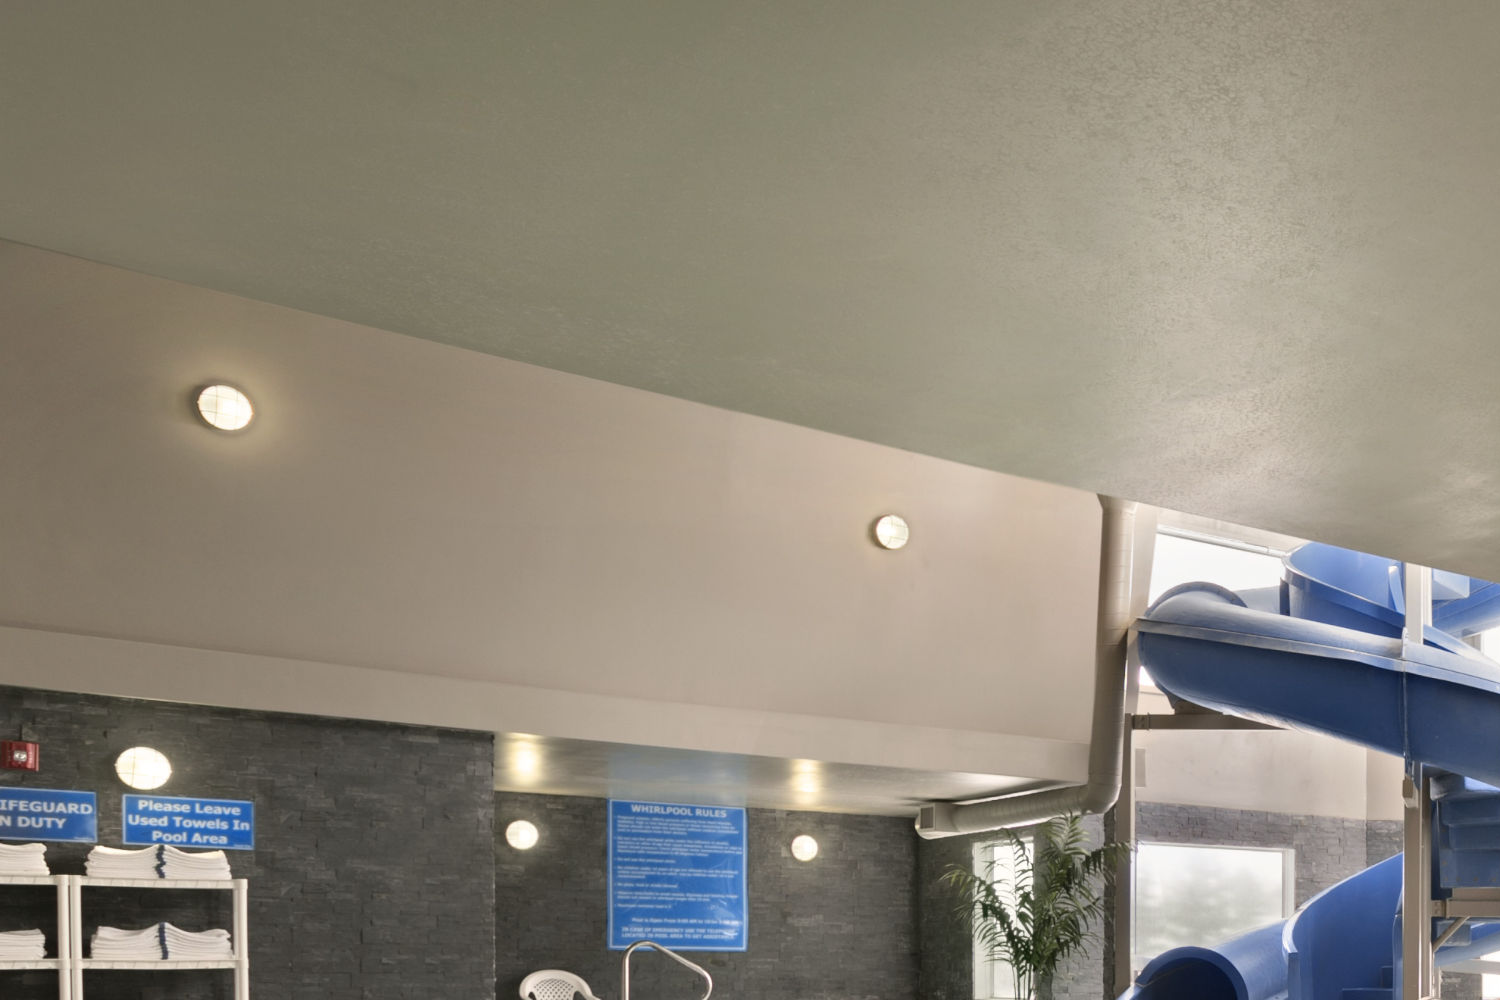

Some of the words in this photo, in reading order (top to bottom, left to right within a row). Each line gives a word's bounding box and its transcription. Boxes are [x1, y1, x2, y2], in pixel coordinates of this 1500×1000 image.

[138, 800, 191, 813] Please
[195, 803, 241, 816] Leave
[631, 804, 692, 816] WHIRLPOOL
[695, 808, 727, 818] RULES
[17, 816, 67, 829] DUTY
[128, 814, 168, 827] Used
[172, 816, 229, 830] Towels
[232, 820, 250, 831] In
[152, 830, 187, 842] Pool
[191, 833, 228, 844] Area
